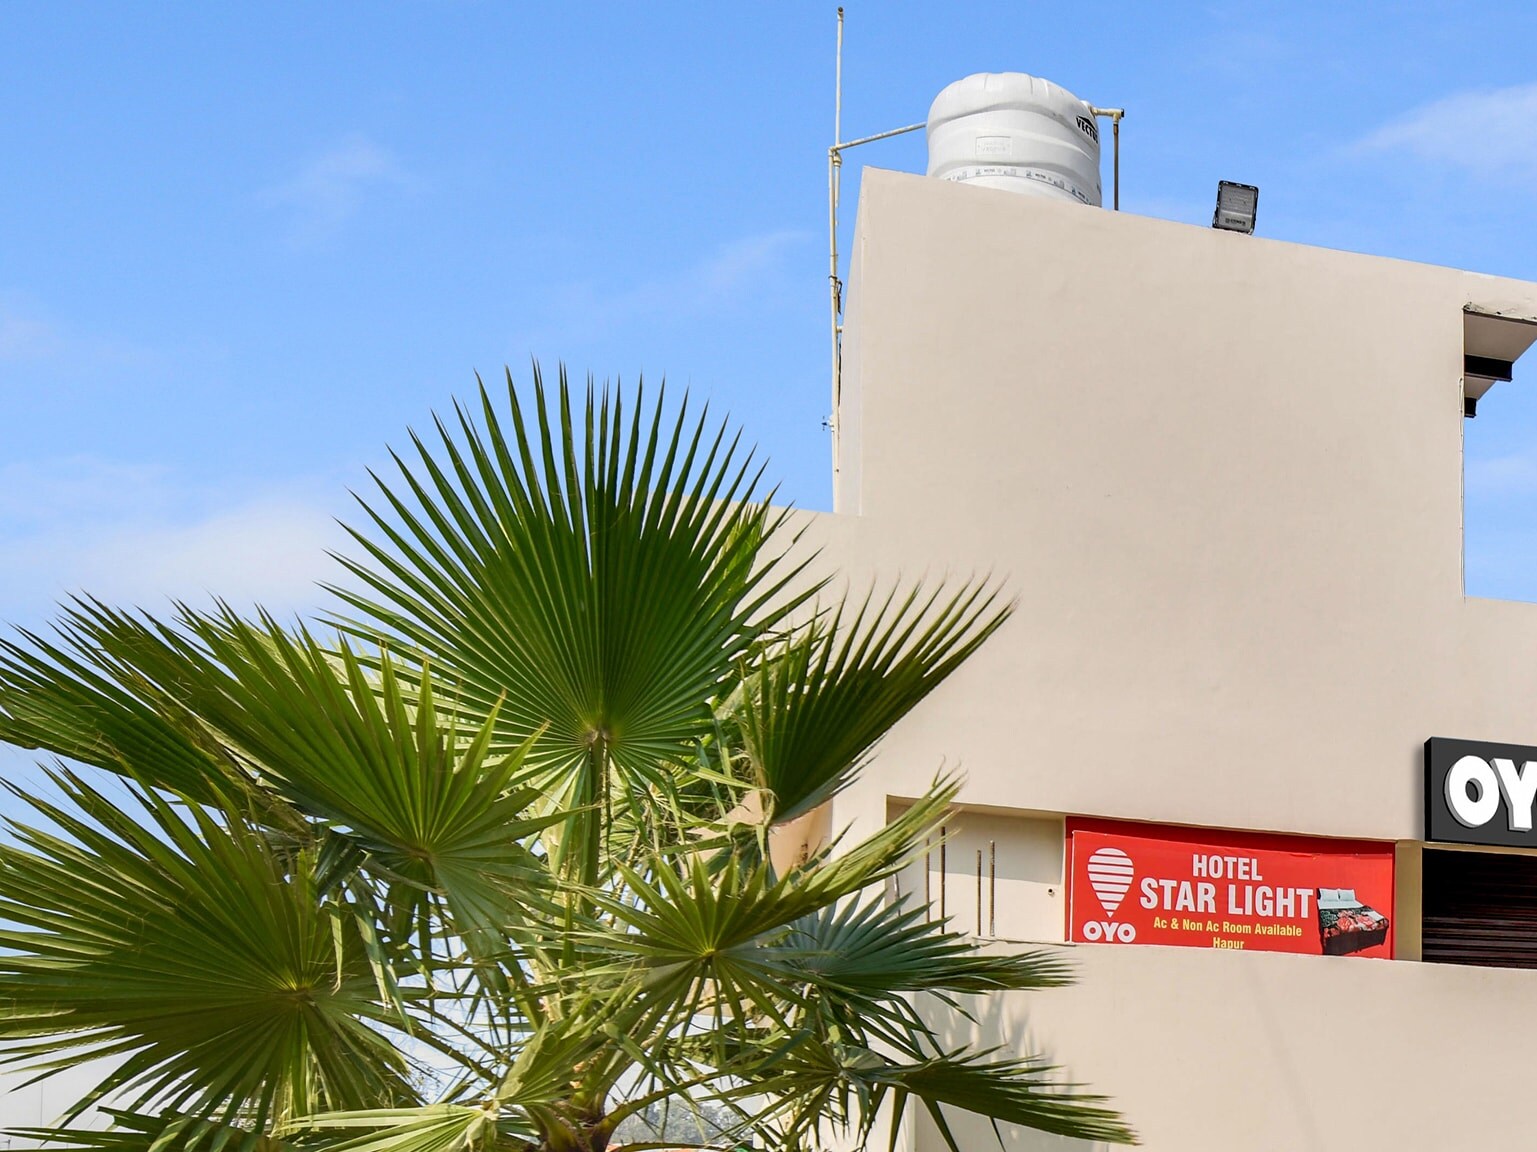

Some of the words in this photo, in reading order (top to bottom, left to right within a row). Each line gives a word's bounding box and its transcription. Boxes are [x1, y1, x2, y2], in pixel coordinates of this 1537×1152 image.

[1192, 854, 1263, 881] HOTEL
[1140, 877, 1217, 914] STAR
[1228, 884, 1314, 919] LIGHT
[1083, 920, 1136, 944] OYO
[1153, 916, 1168, 930] Ac
[1170, 917, 1179, 930] &
[1182, 919, 1203, 932] Non
[1206, 920, 1220, 933] Ac
[1222, 921, 1252, 935] Room
[1254, 923, 1302, 938] Available
[1212, 936, 1245, 949] Hapur
